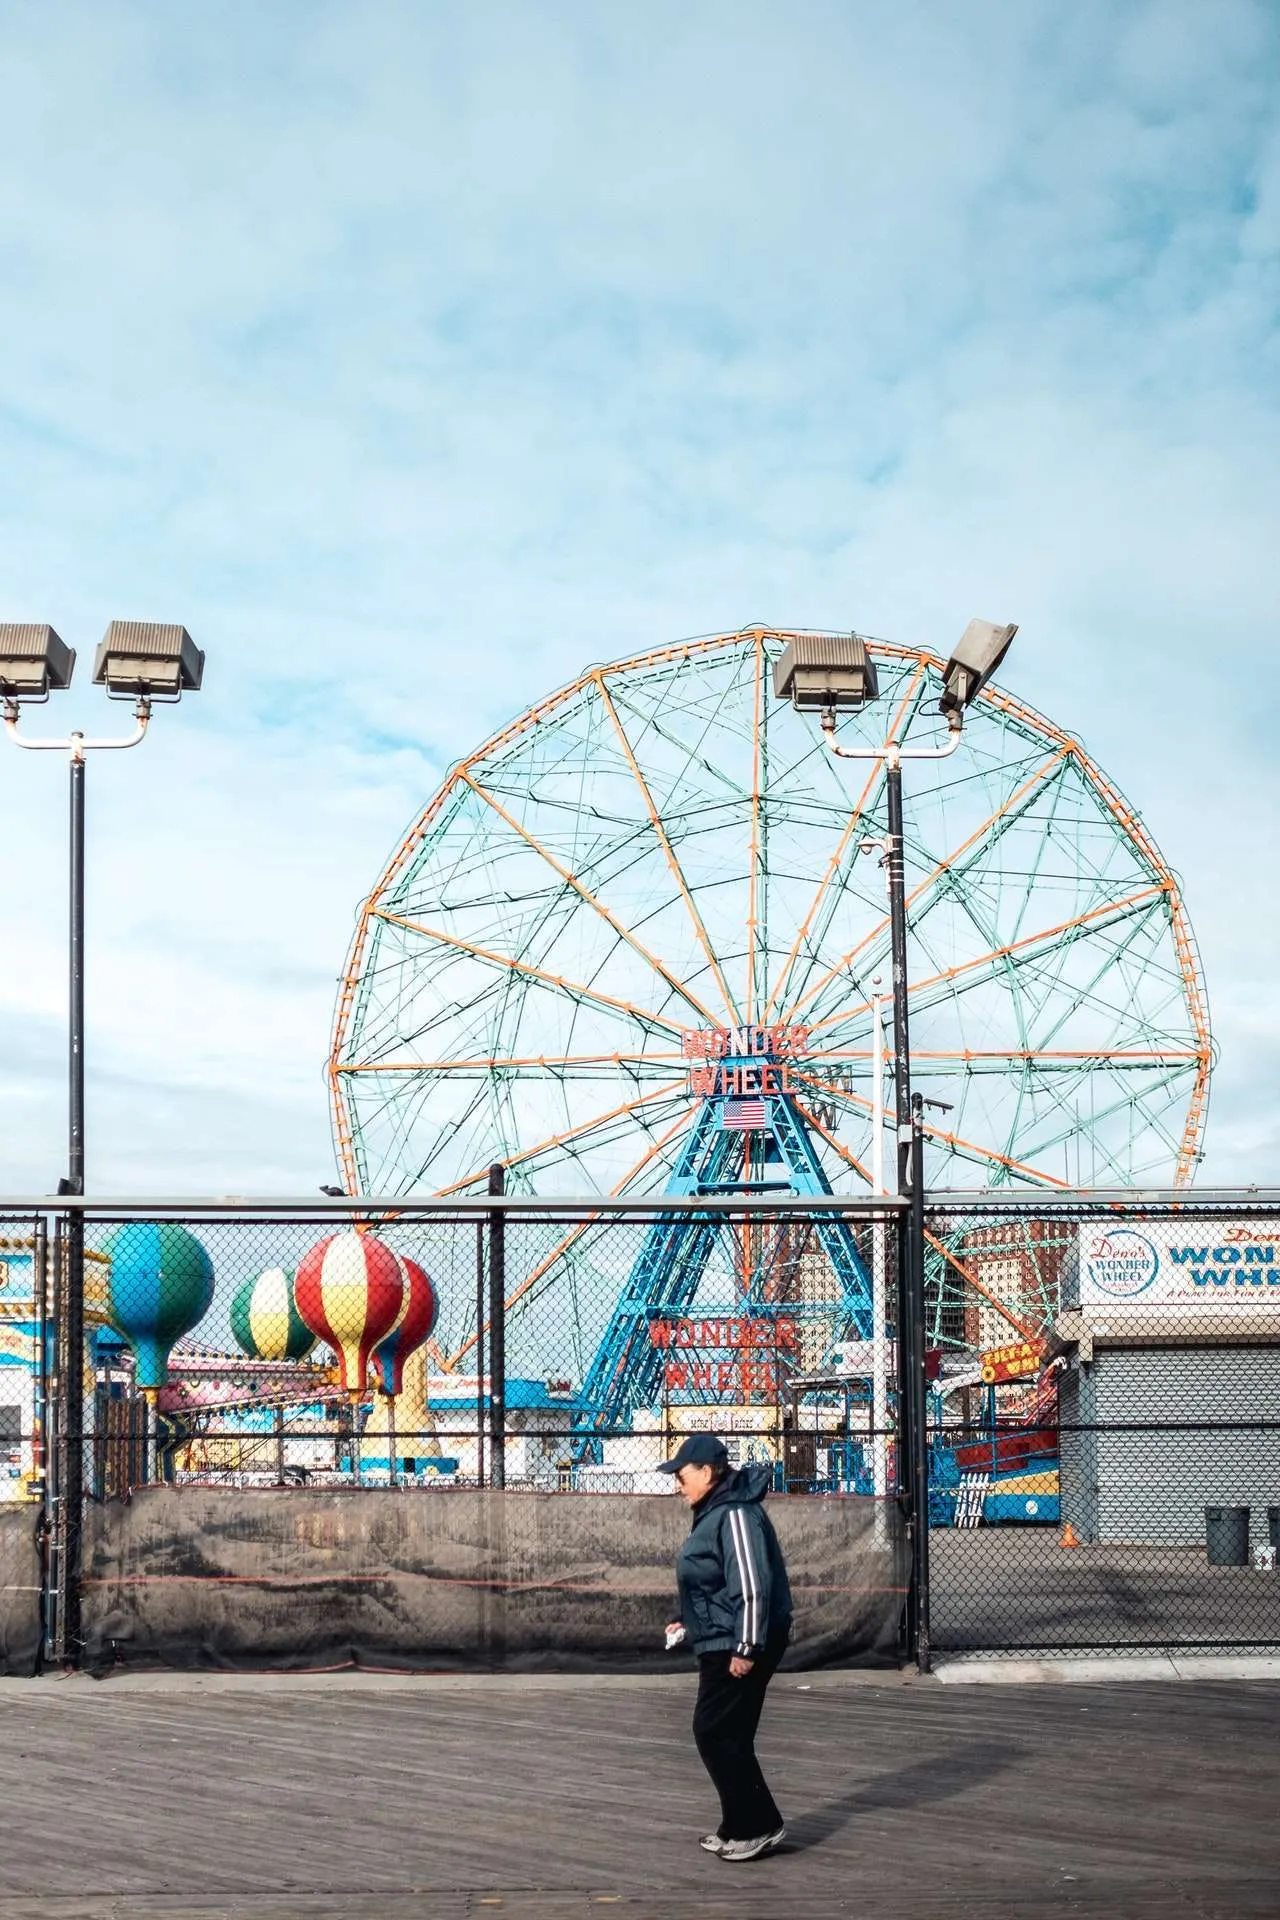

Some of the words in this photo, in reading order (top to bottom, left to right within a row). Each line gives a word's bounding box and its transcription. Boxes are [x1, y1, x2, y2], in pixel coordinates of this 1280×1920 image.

[682, 1024, 808, 1058] WONDER
[690, 1065, 800, 1095] WHEEL
[1090, 1239, 1145, 1259] Deno's
[1169, 1247, 1274, 1264] WON
[1096, 1260, 1150, 1270] WONDER
[1102, 1271, 1144, 1281] WHEEL
[649, 1318, 797, 1349] WONDER
[665, 1362, 778, 1391] WHEEL
